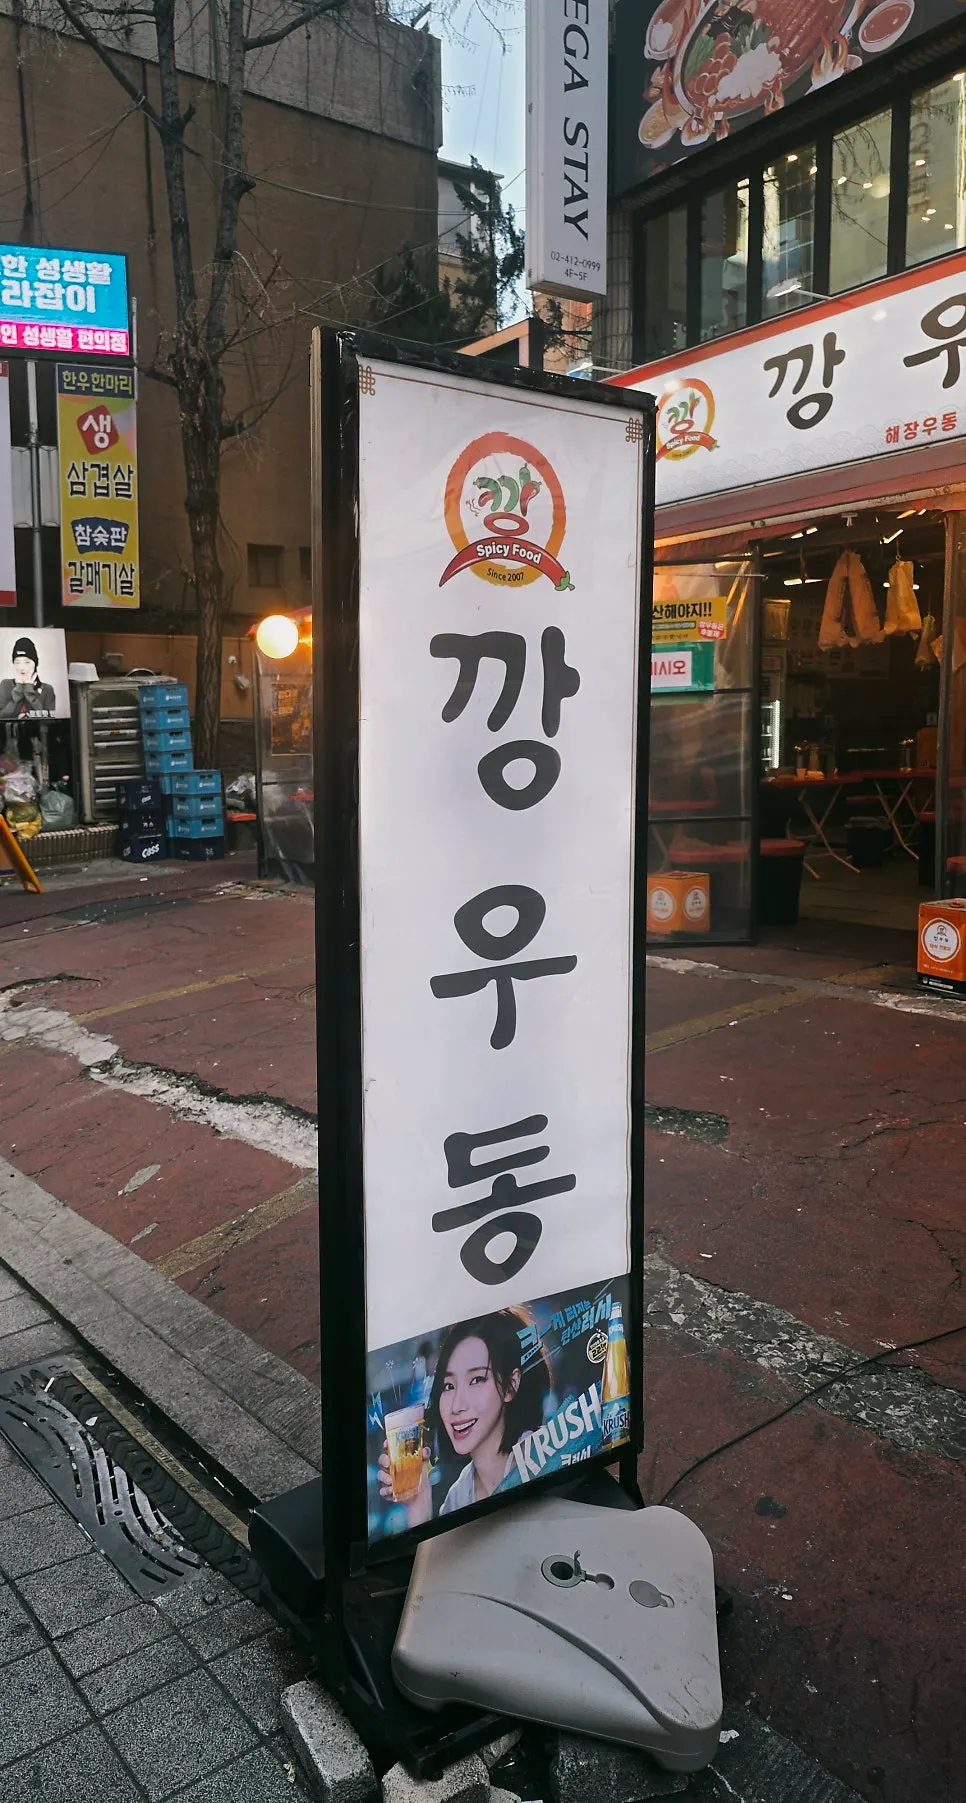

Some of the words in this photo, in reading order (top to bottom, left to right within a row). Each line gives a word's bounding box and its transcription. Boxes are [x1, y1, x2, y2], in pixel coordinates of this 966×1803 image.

[563, 0, 589, 92] EGA
[563, 116, 589, 241] STAY
[0, 254, 28, 278] 한
[36, 257, 112, 285] 성생활
[550, 250, 601, 271] 02-412-0999
[23, 326, 73, 349] 성생활
[77, 329, 127, 353] 편의점
[82, 414, 112, 449] 생
[885, 411, 957, 444] 해장우동
[67, 461, 134, 499] 삼겹살
[75, 524, 127, 547] 참숯판
[476, 542, 509, 557] Spicy
[511, 544, 542, 564] Food
[68, 560, 135, 596] 갈매기살
[486, 567, 506, 581] Since
[507, 571, 524, 581] 2007
[652, 661, 686, 676] 시오
[141, 843, 160, 859] Cass
[512, 1383, 602, 1484] KRUSH
[603, 1411, 630, 1438] KRUSH
